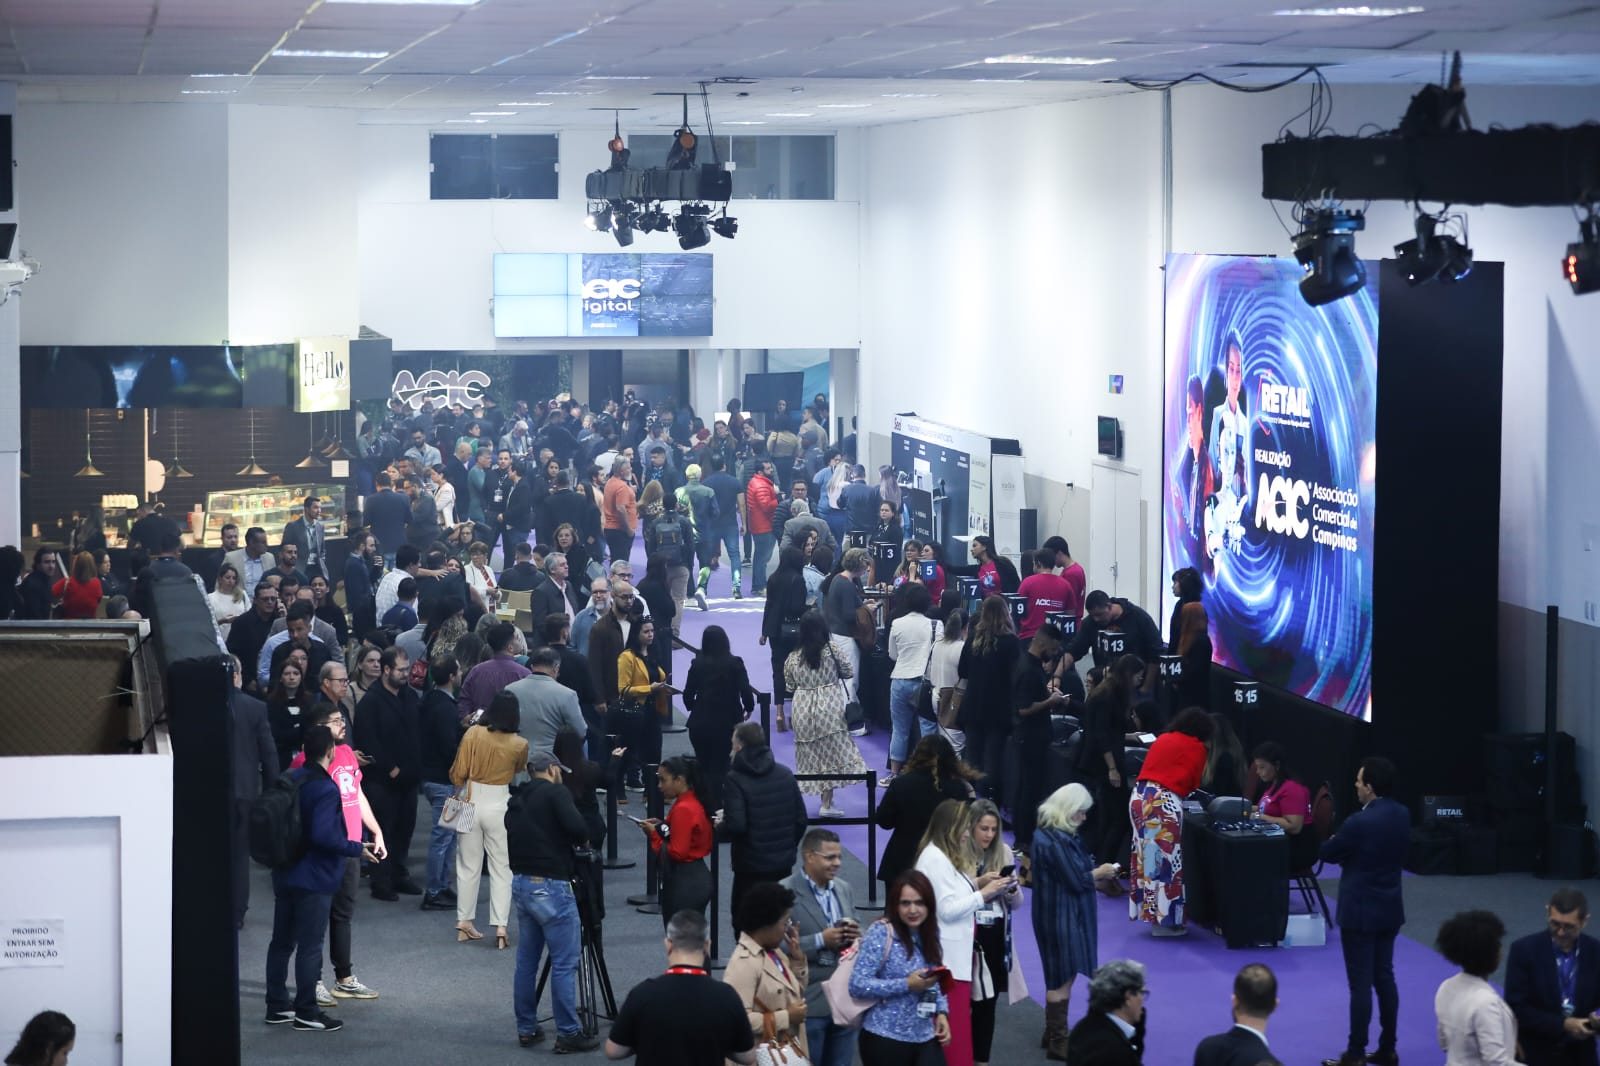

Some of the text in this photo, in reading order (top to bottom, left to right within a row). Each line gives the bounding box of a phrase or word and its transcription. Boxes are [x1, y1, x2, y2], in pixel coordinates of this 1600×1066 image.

[583, 278, 641, 300] CIC
[583, 300, 634, 315] igital
[387, 370, 491, 410] ACIC
[1262, 383, 1310, 417] RETAIL
[1255, 449, 1291, 469] REALIZAÇÃO
[1312, 482, 1358, 507] Associação
[1255, 472, 1310, 539] ACIC
[1312, 504, 1350, 529] Comercial
[1312, 525, 1358, 552] Campinas
[887, 549, 894, 559] 3
[926, 565, 933, 576] 5
[969, 585, 978, 596] 7
[1017, 603, 1025, 614] 9
[1063, 621, 1075, 633] 11
[1111, 639, 1124, 652] 13
[1169, 662, 1182, 675] 14
[1234, 689, 1243, 703] 15
[1245, 689, 1258, 703] 15
[338, 773, 357, 794] R
[1436, 808, 1463, 816] RETAIL
[12, 927, 49, 935] PROIBIDO
[6, 939, 55, 947] ENTRAR SEM
[4, 949, 58, 959] AUTORIZAÇÃO
